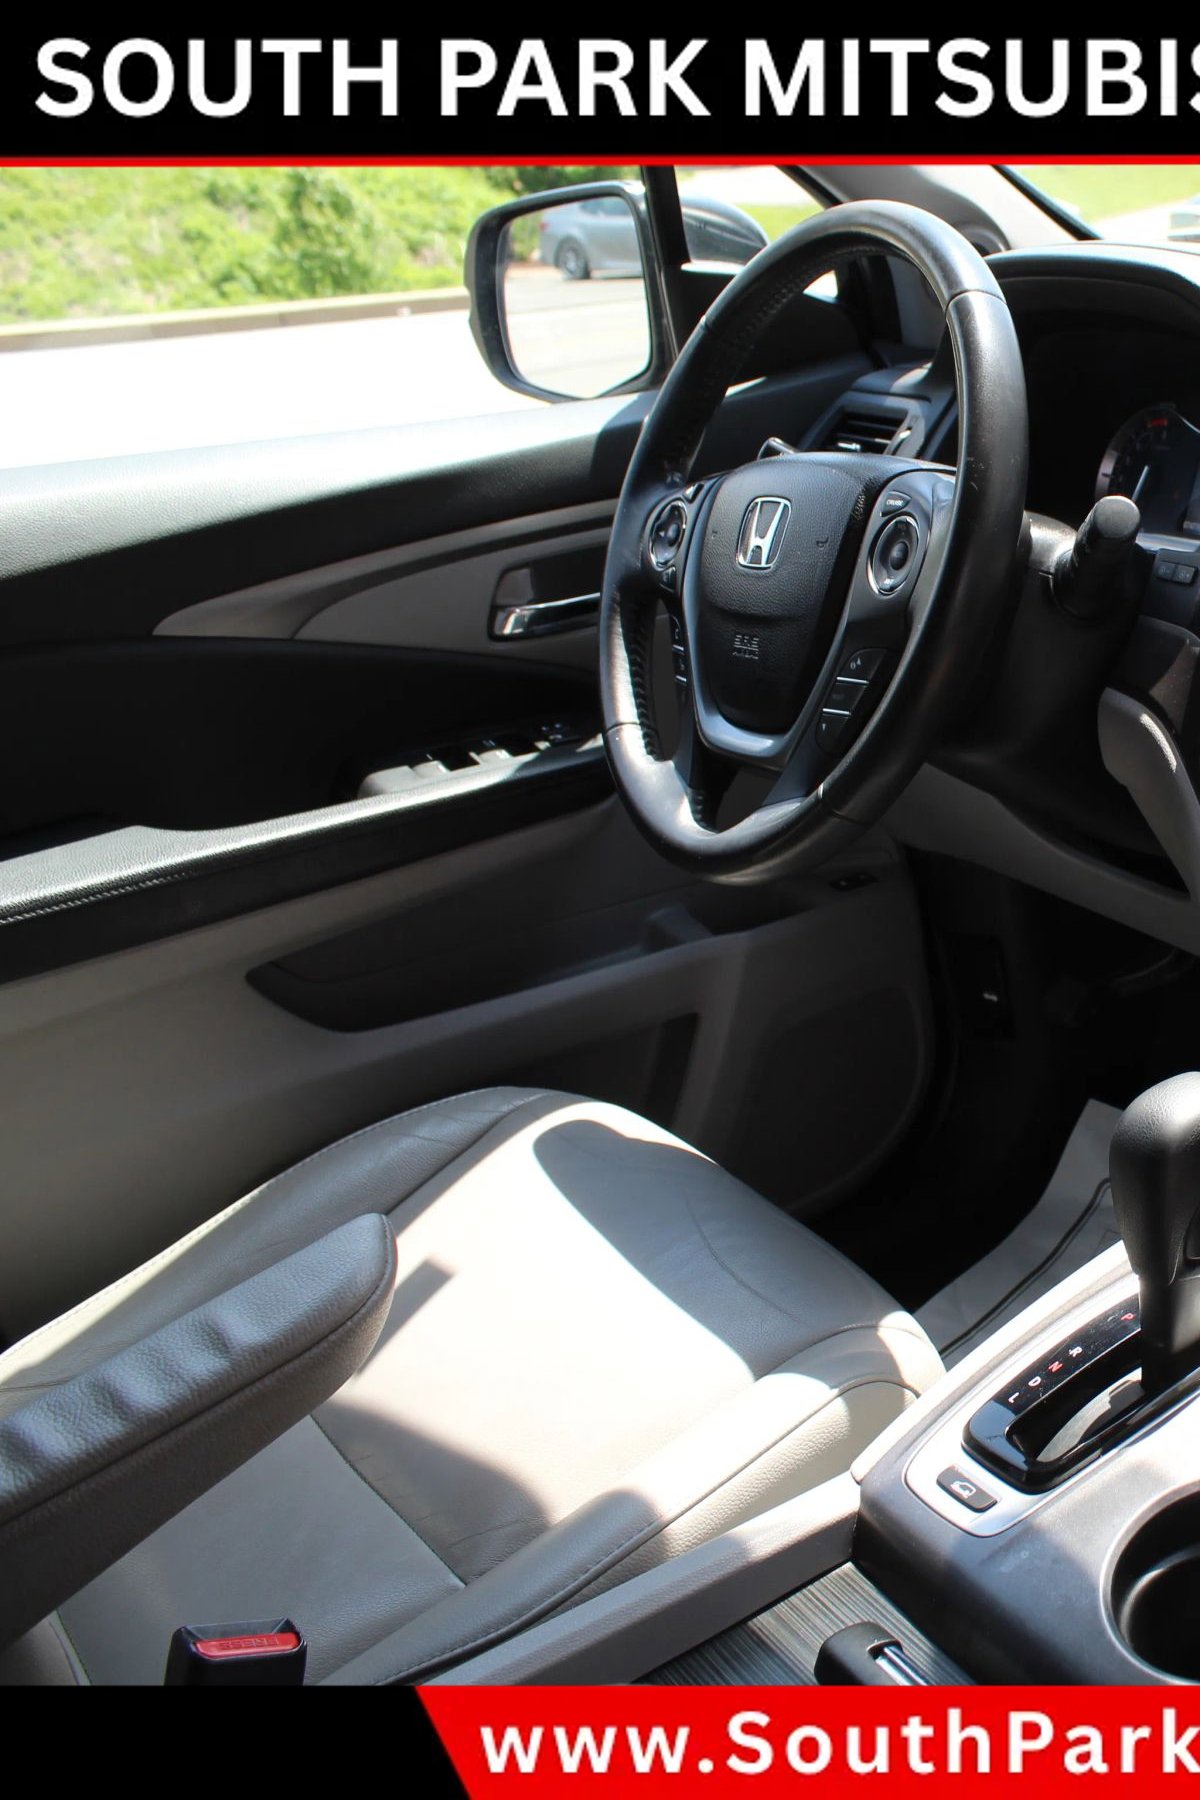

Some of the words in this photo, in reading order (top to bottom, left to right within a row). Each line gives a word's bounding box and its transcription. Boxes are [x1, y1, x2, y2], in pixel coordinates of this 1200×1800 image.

[1121, 1312, 1136, 1321] P
[1068, 1346, 1083, 1357] R
[1048, 1361, 1063, 1372] N
[1028, 1376, 1042, 1387] D
[1008, 1392, 1020, 1404] L
